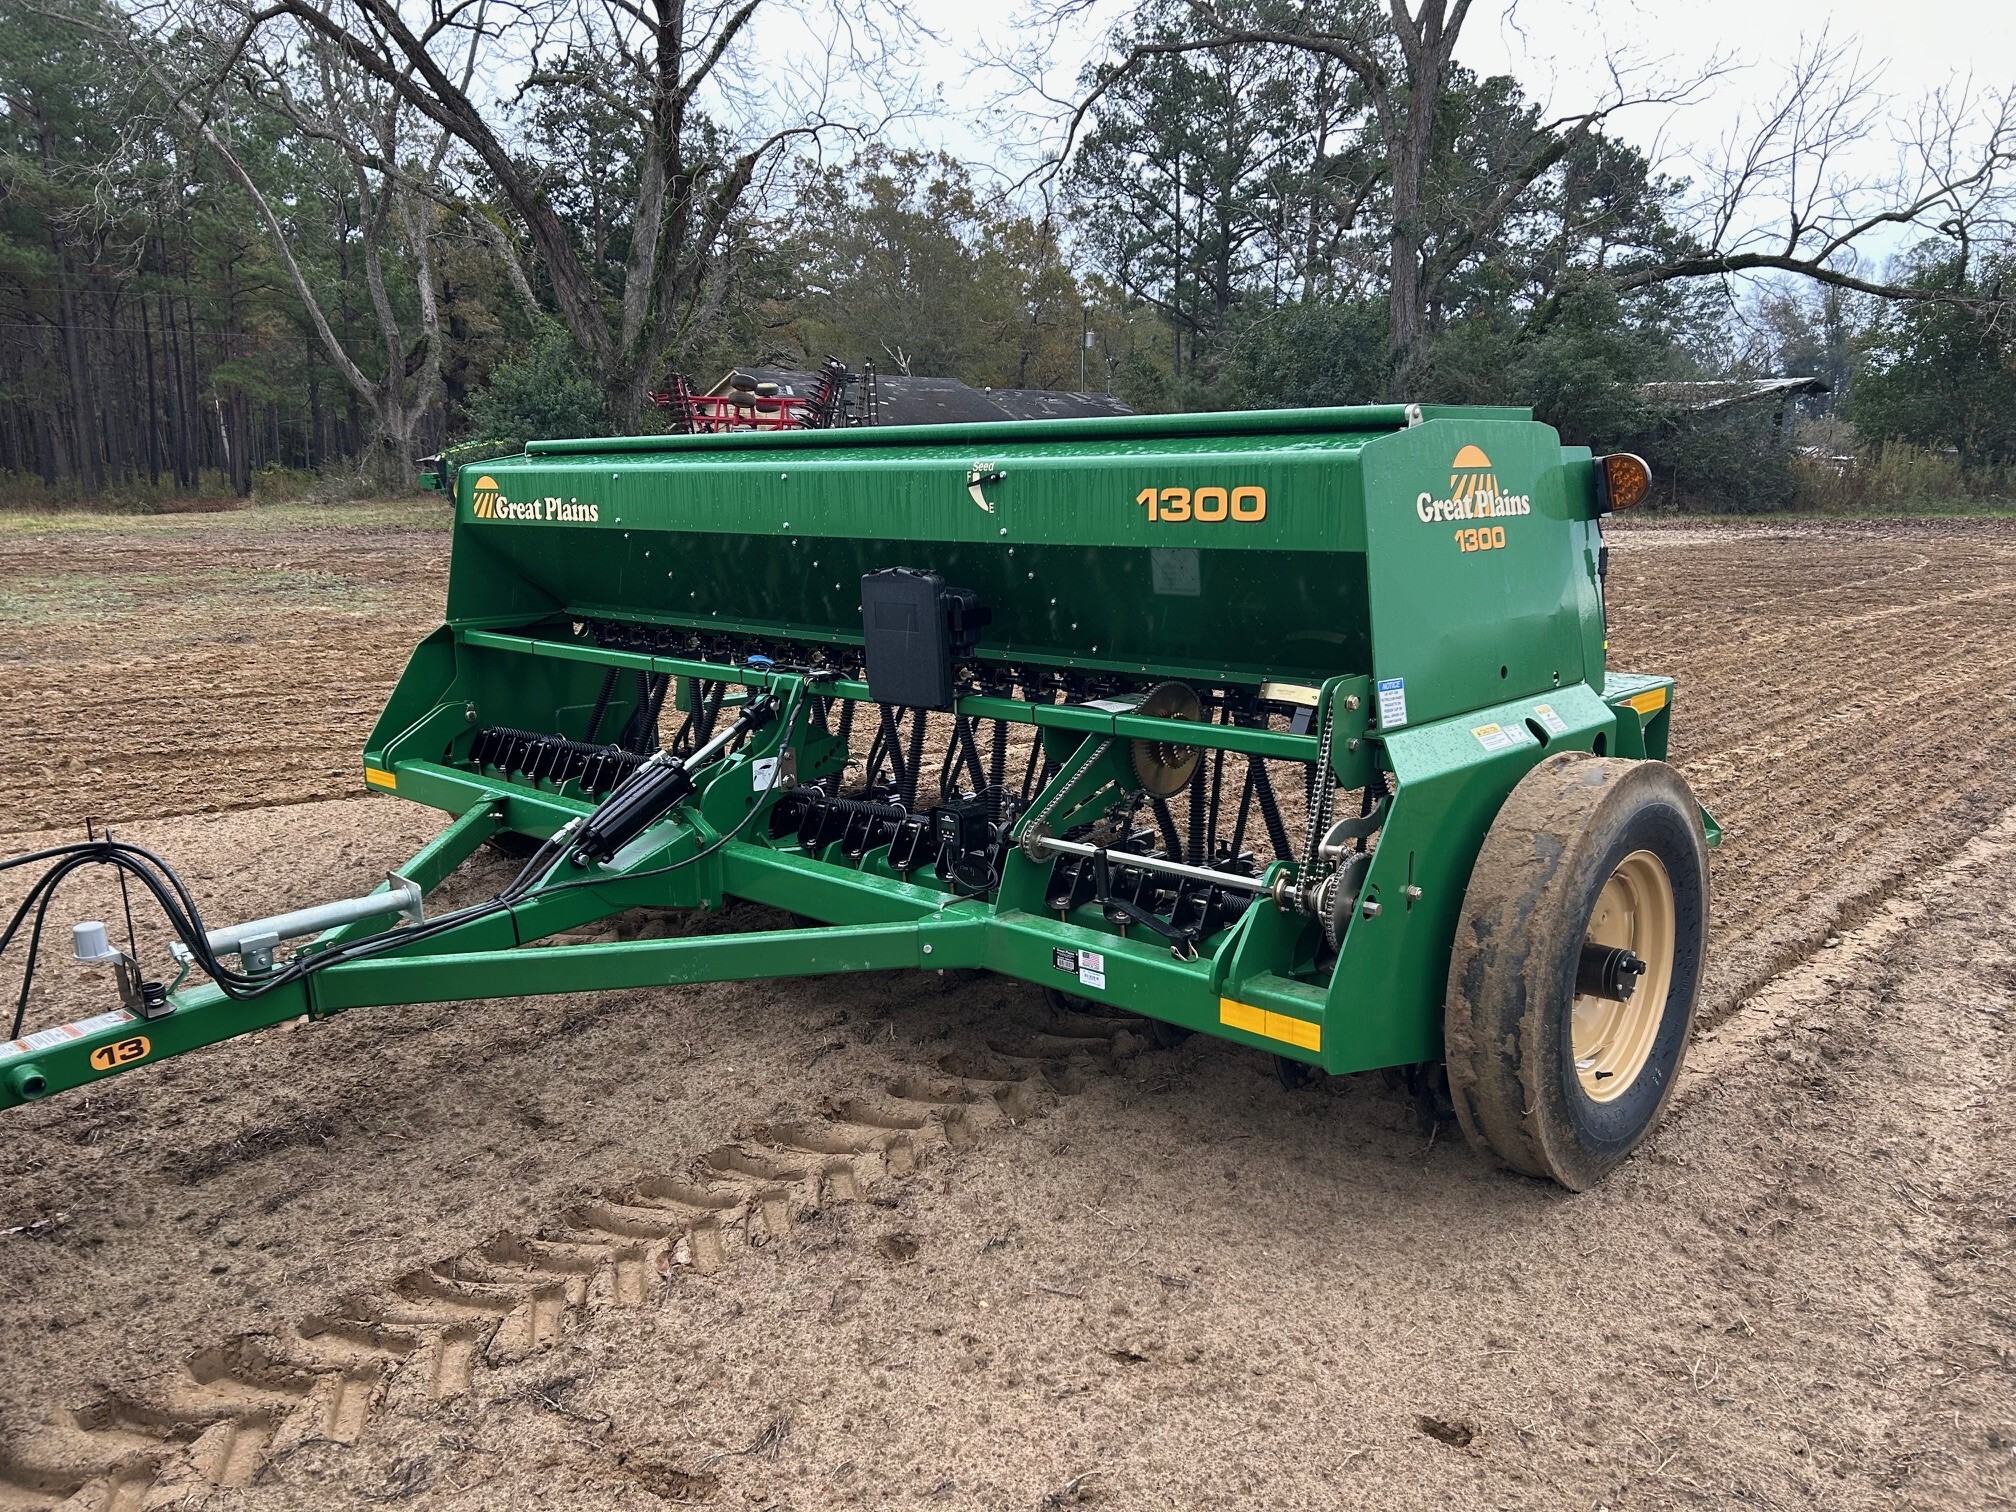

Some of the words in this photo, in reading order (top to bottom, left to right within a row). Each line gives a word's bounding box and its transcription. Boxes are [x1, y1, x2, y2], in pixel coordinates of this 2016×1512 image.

[966, 471, 972, 482] F
[972, 460, 995, 472] Seed
[495, 496, 542, 519] Great
[544, 497, 599, 522] Plains
[988, 502, 995, 513] E
[1136, 486, 1267, 522] 1300
[1416, 492, 1474, 523] Great
[1474, 488, 1531, 518] Plains
[1454, 526, 1506, 553] 1300
[1381, 680, 1401, 690] NOTICE
[96, 1038, 145, 1066] 13
